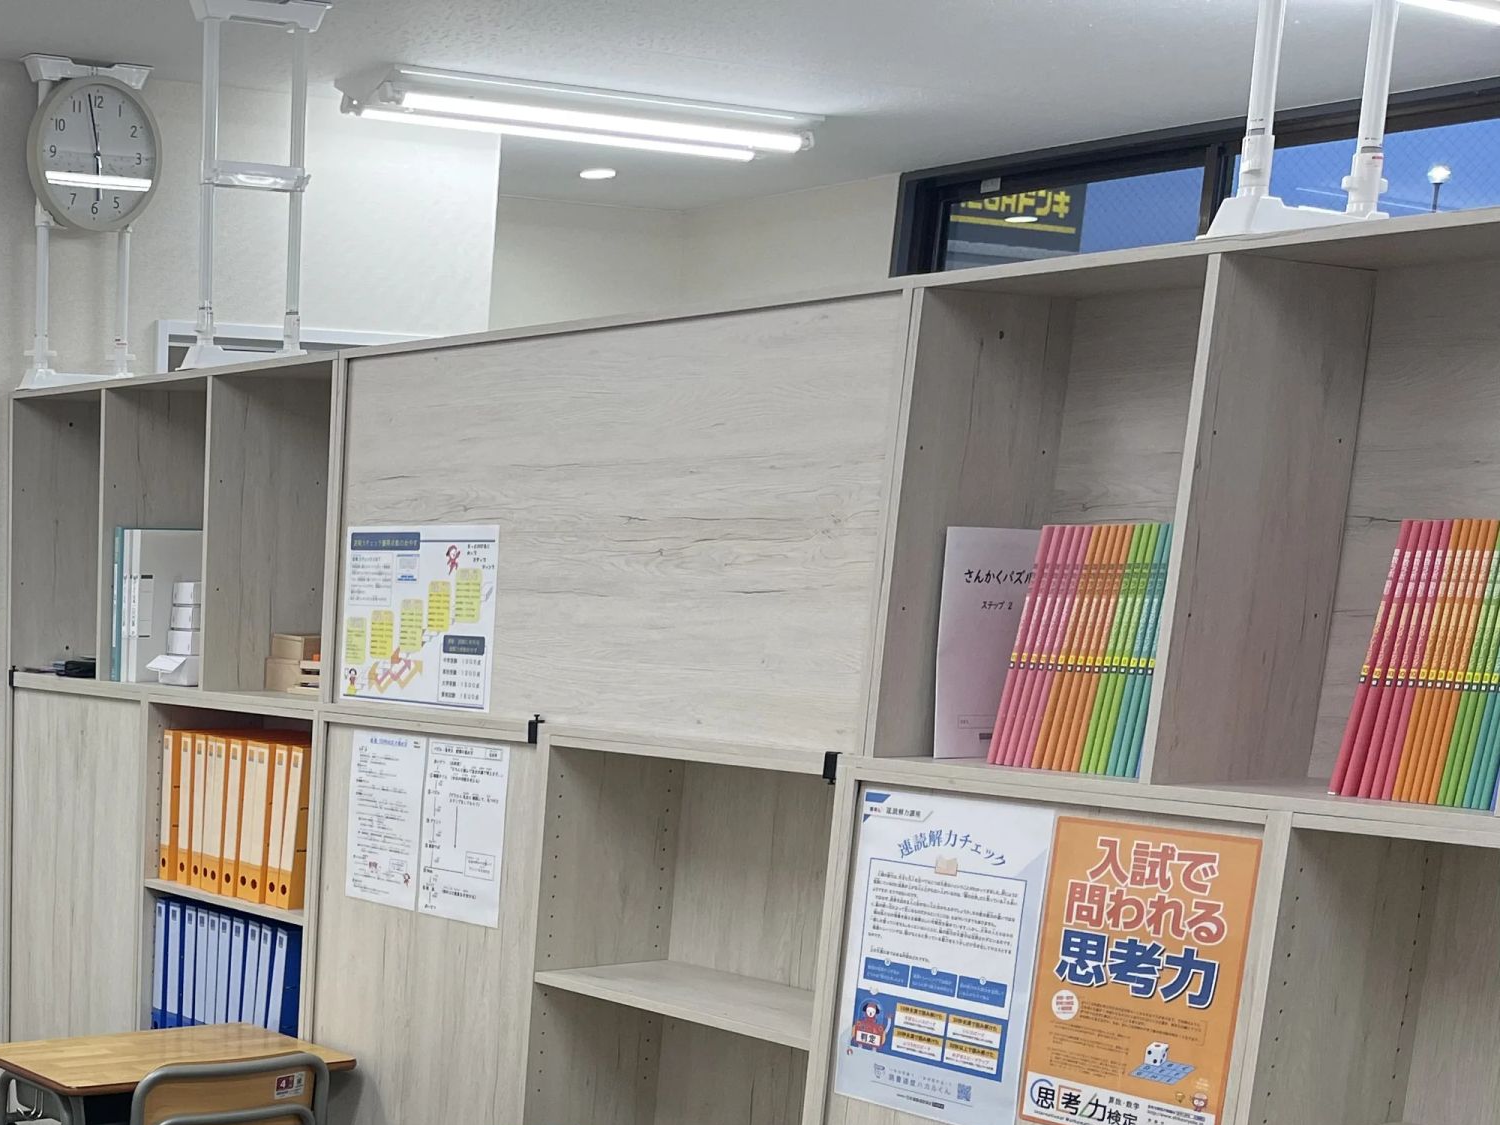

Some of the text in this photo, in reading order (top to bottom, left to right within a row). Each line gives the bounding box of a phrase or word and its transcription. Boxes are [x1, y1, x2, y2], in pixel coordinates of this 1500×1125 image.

[73, 100, 82, 113] 11
[94, 95, 104, 109] 12
[55, 118, 66, 132] 10
[130, 125, 138, 138] 2
[49, 144, 57, 158] 9
[135, 152, 142, 166] 3
[69, 193, 77, 205] 7
[113, 196, 120, 209] 5
[91, 202, 99, 215] 6
[1006, 601, 1013, 610] 2
[897, 829, 1006, 867] 速読解力チェック
[1087, 836, 1219, 895] 入試で
[1064, 880, 1227, 945] 問われる
[1054, 928, 1220, 1009] 思考力
[860, 1033, 877, 1044] 判定
